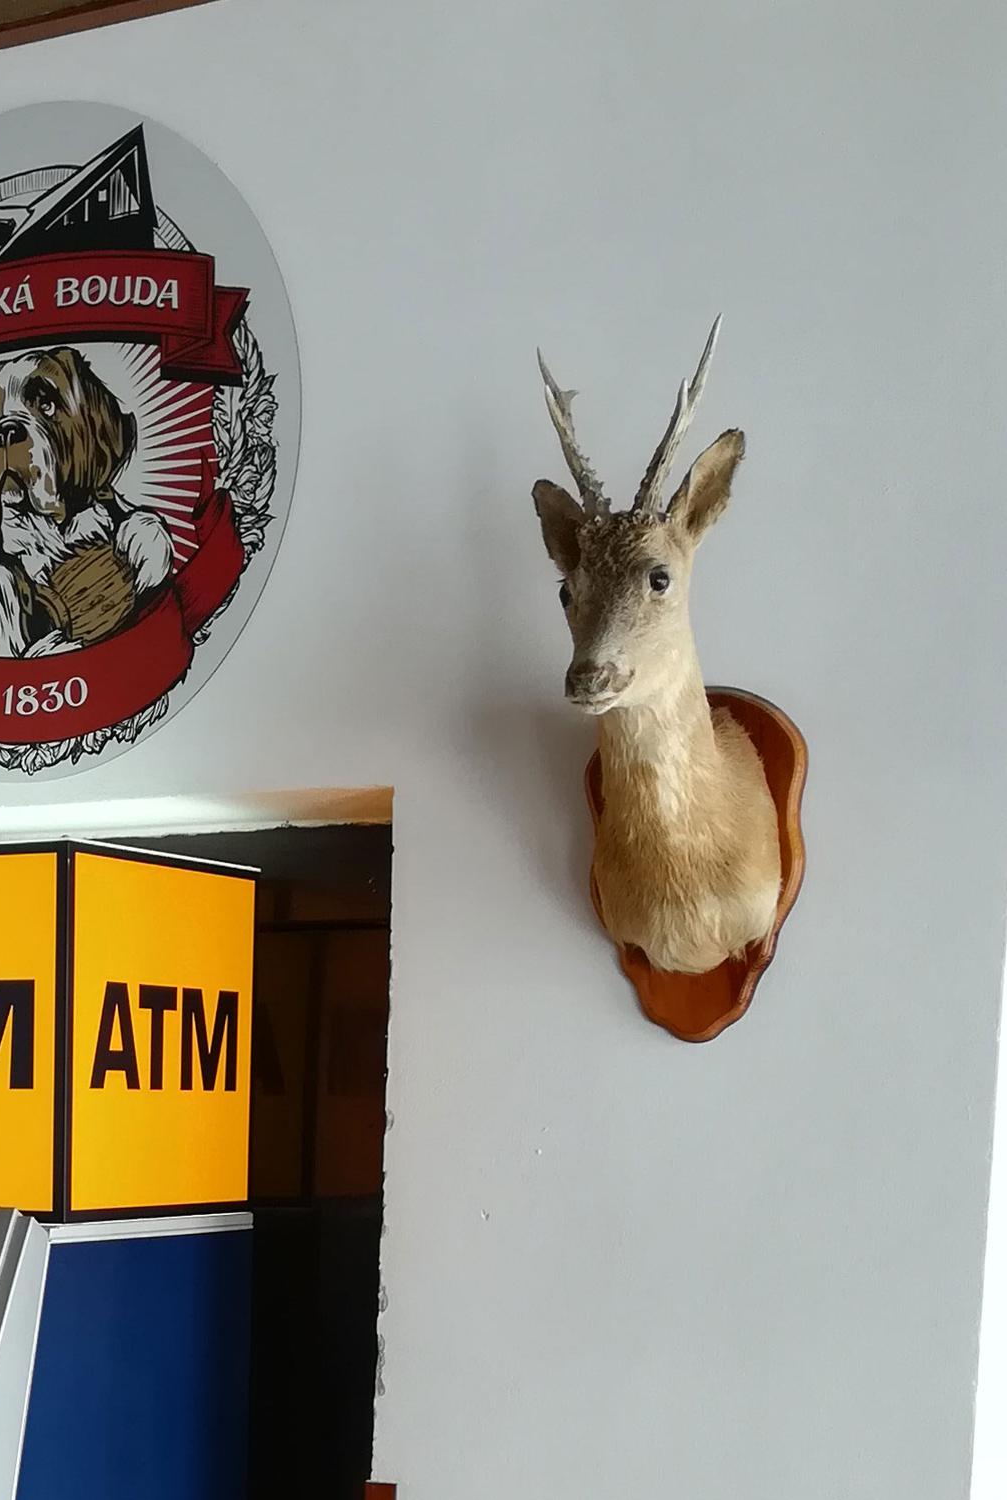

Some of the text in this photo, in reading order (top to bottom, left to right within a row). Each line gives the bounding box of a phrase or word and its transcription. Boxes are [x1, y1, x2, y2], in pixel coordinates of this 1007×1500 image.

[54, 275, 180, 310] BOUDA
[1, 676, 89, 717] 1830
[89, 980, 240, 1093] ATM
